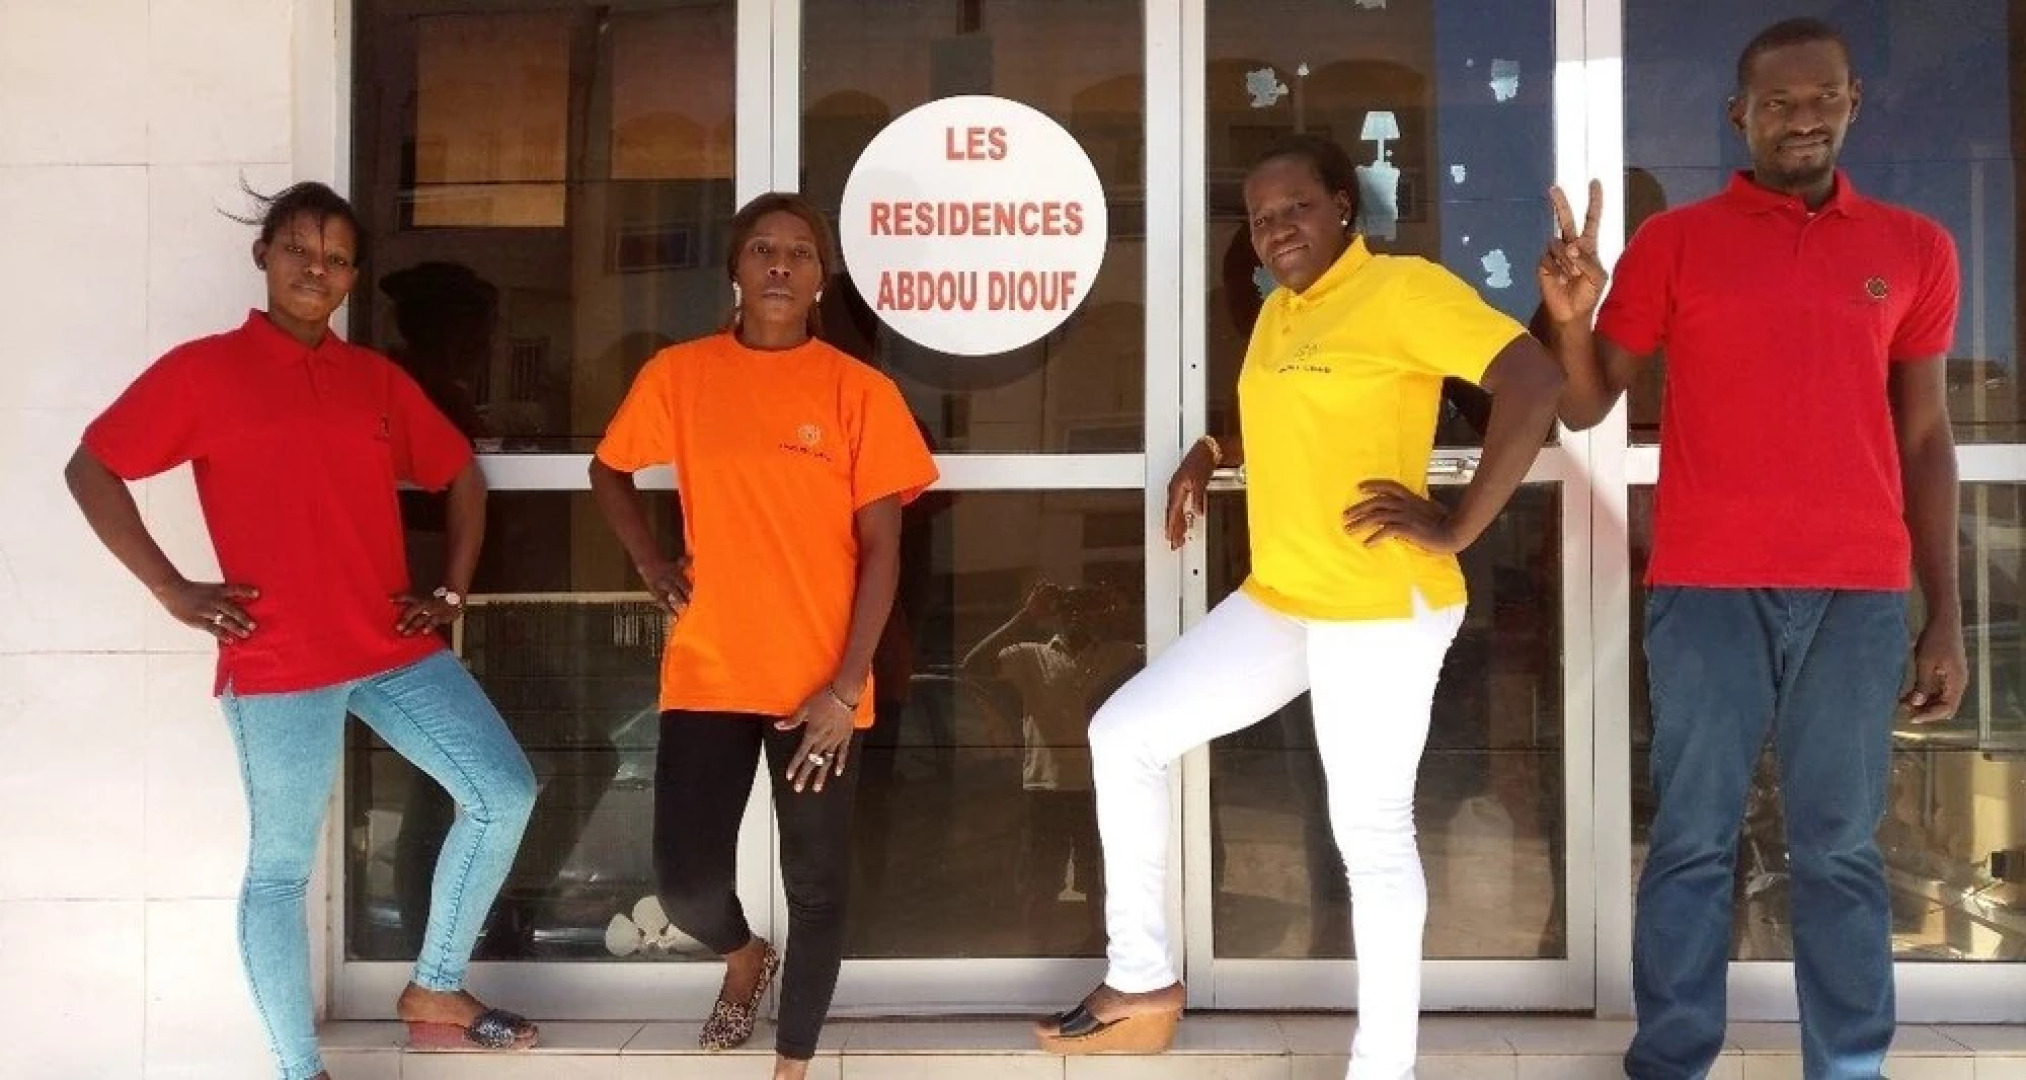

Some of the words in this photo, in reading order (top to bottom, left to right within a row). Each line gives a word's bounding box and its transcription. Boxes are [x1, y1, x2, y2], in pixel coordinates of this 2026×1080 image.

[945, 126, 1008, 161] LES
[869, 202, 1084, 236] RESIDENCES
[876, 271, 977, 311] ABDOU
[987, 271, 1077, 311] DIOUF
